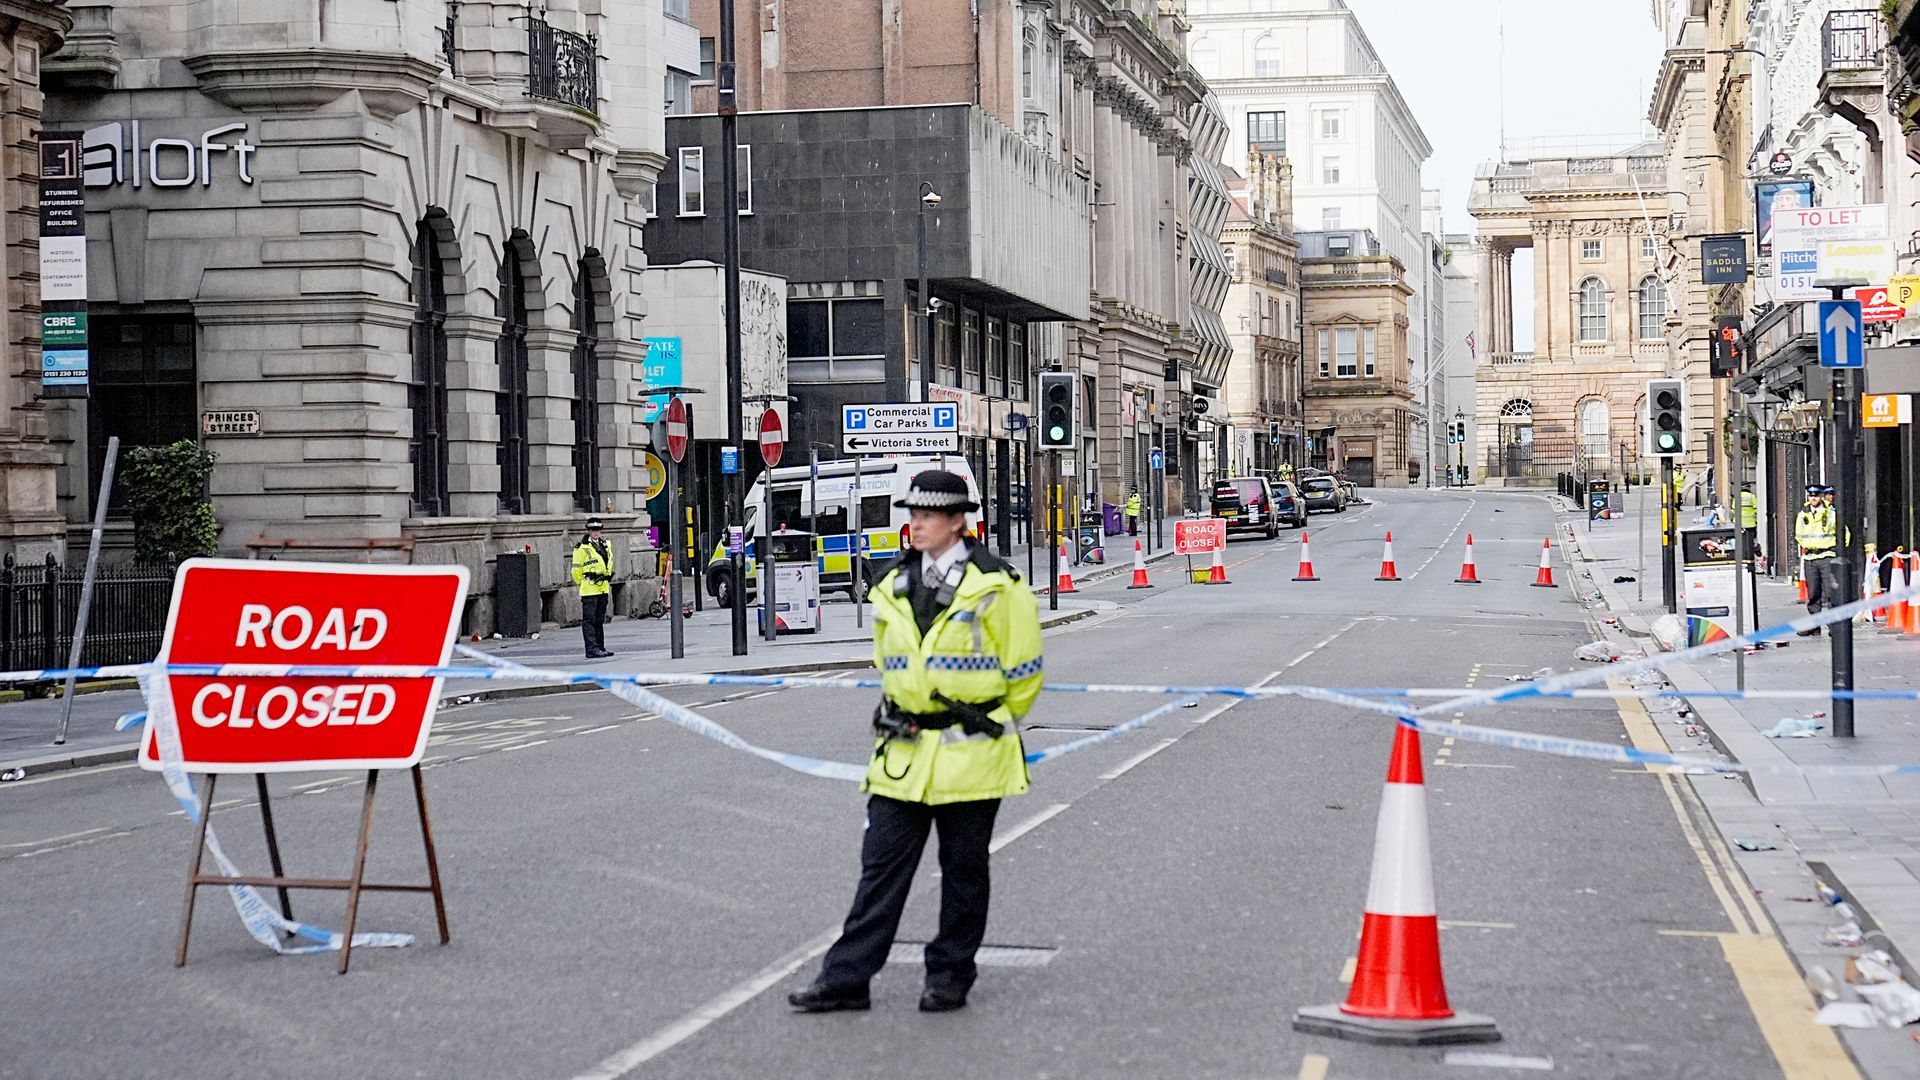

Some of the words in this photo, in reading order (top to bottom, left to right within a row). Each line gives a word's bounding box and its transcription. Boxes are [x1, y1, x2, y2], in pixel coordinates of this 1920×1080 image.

[1797, 212, 1822, 226] TO
[1829, 210, 1862, 225] LET
[1826, 244, 1885, 257] Lemon
[1706, 257, 1743, 266] SADDLE
[1781, 276, 1811, 288] 0151
[44, 316, 77, 327] CBRE
[867, 406, 931, 417] Commercial
[208, 413, 253, 422] PRINCES
[210, 423, 253, 432] STREET
[874, 419, 893, 429] Car
[897, 419, 928, 428] Parks
[871, 438, 912, 448] Victoria
[915, 437, 949, 448] Street
[1185, 525, 1215, 535] ROAD
[1180, 538, 1217, 549] CLOSE
[235, 603, 389, 651] ROAD
[191, 682, 397, 730] CLOSED
